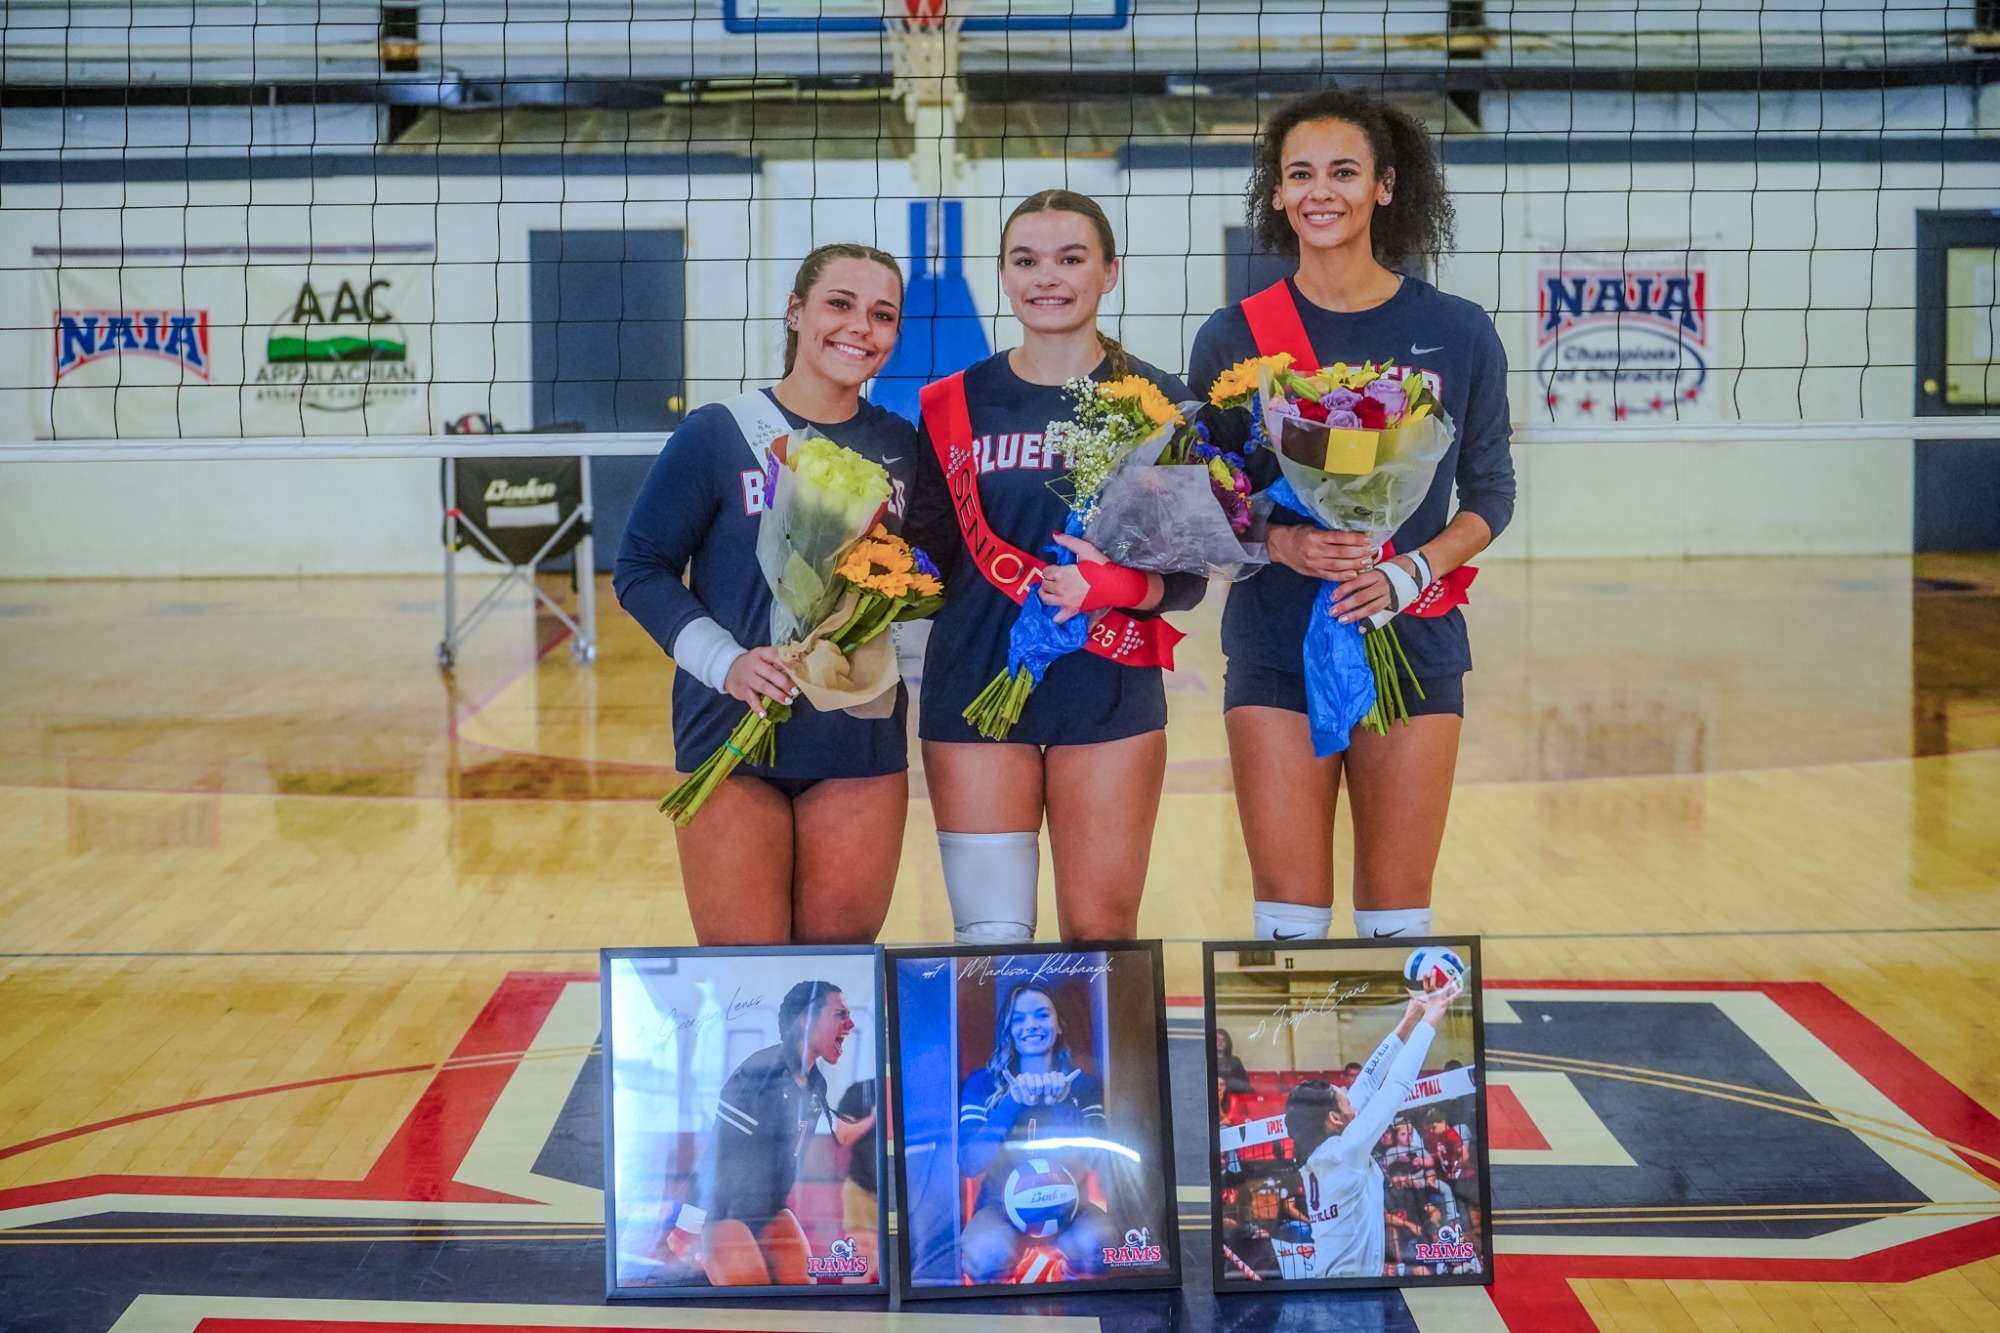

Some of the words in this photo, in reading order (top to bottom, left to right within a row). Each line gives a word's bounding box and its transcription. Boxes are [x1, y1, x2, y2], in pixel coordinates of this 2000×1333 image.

[292, 280, 392, 323] AAC
[1545, 277, 1697, 333] NAIA
[59, 316, 203, 368] NAIA
[255, 364, 417, 383] APPALACHIAN
[957, 956, 1034, 986] Madison
[1030, 951, 1114, 984] Rodabaugh
[1103, 1245, 1160, 1264] RAMS
[1416, 1242, 1474, 1259] RAMS
[808, 1257, 867, 1273] RAMS
